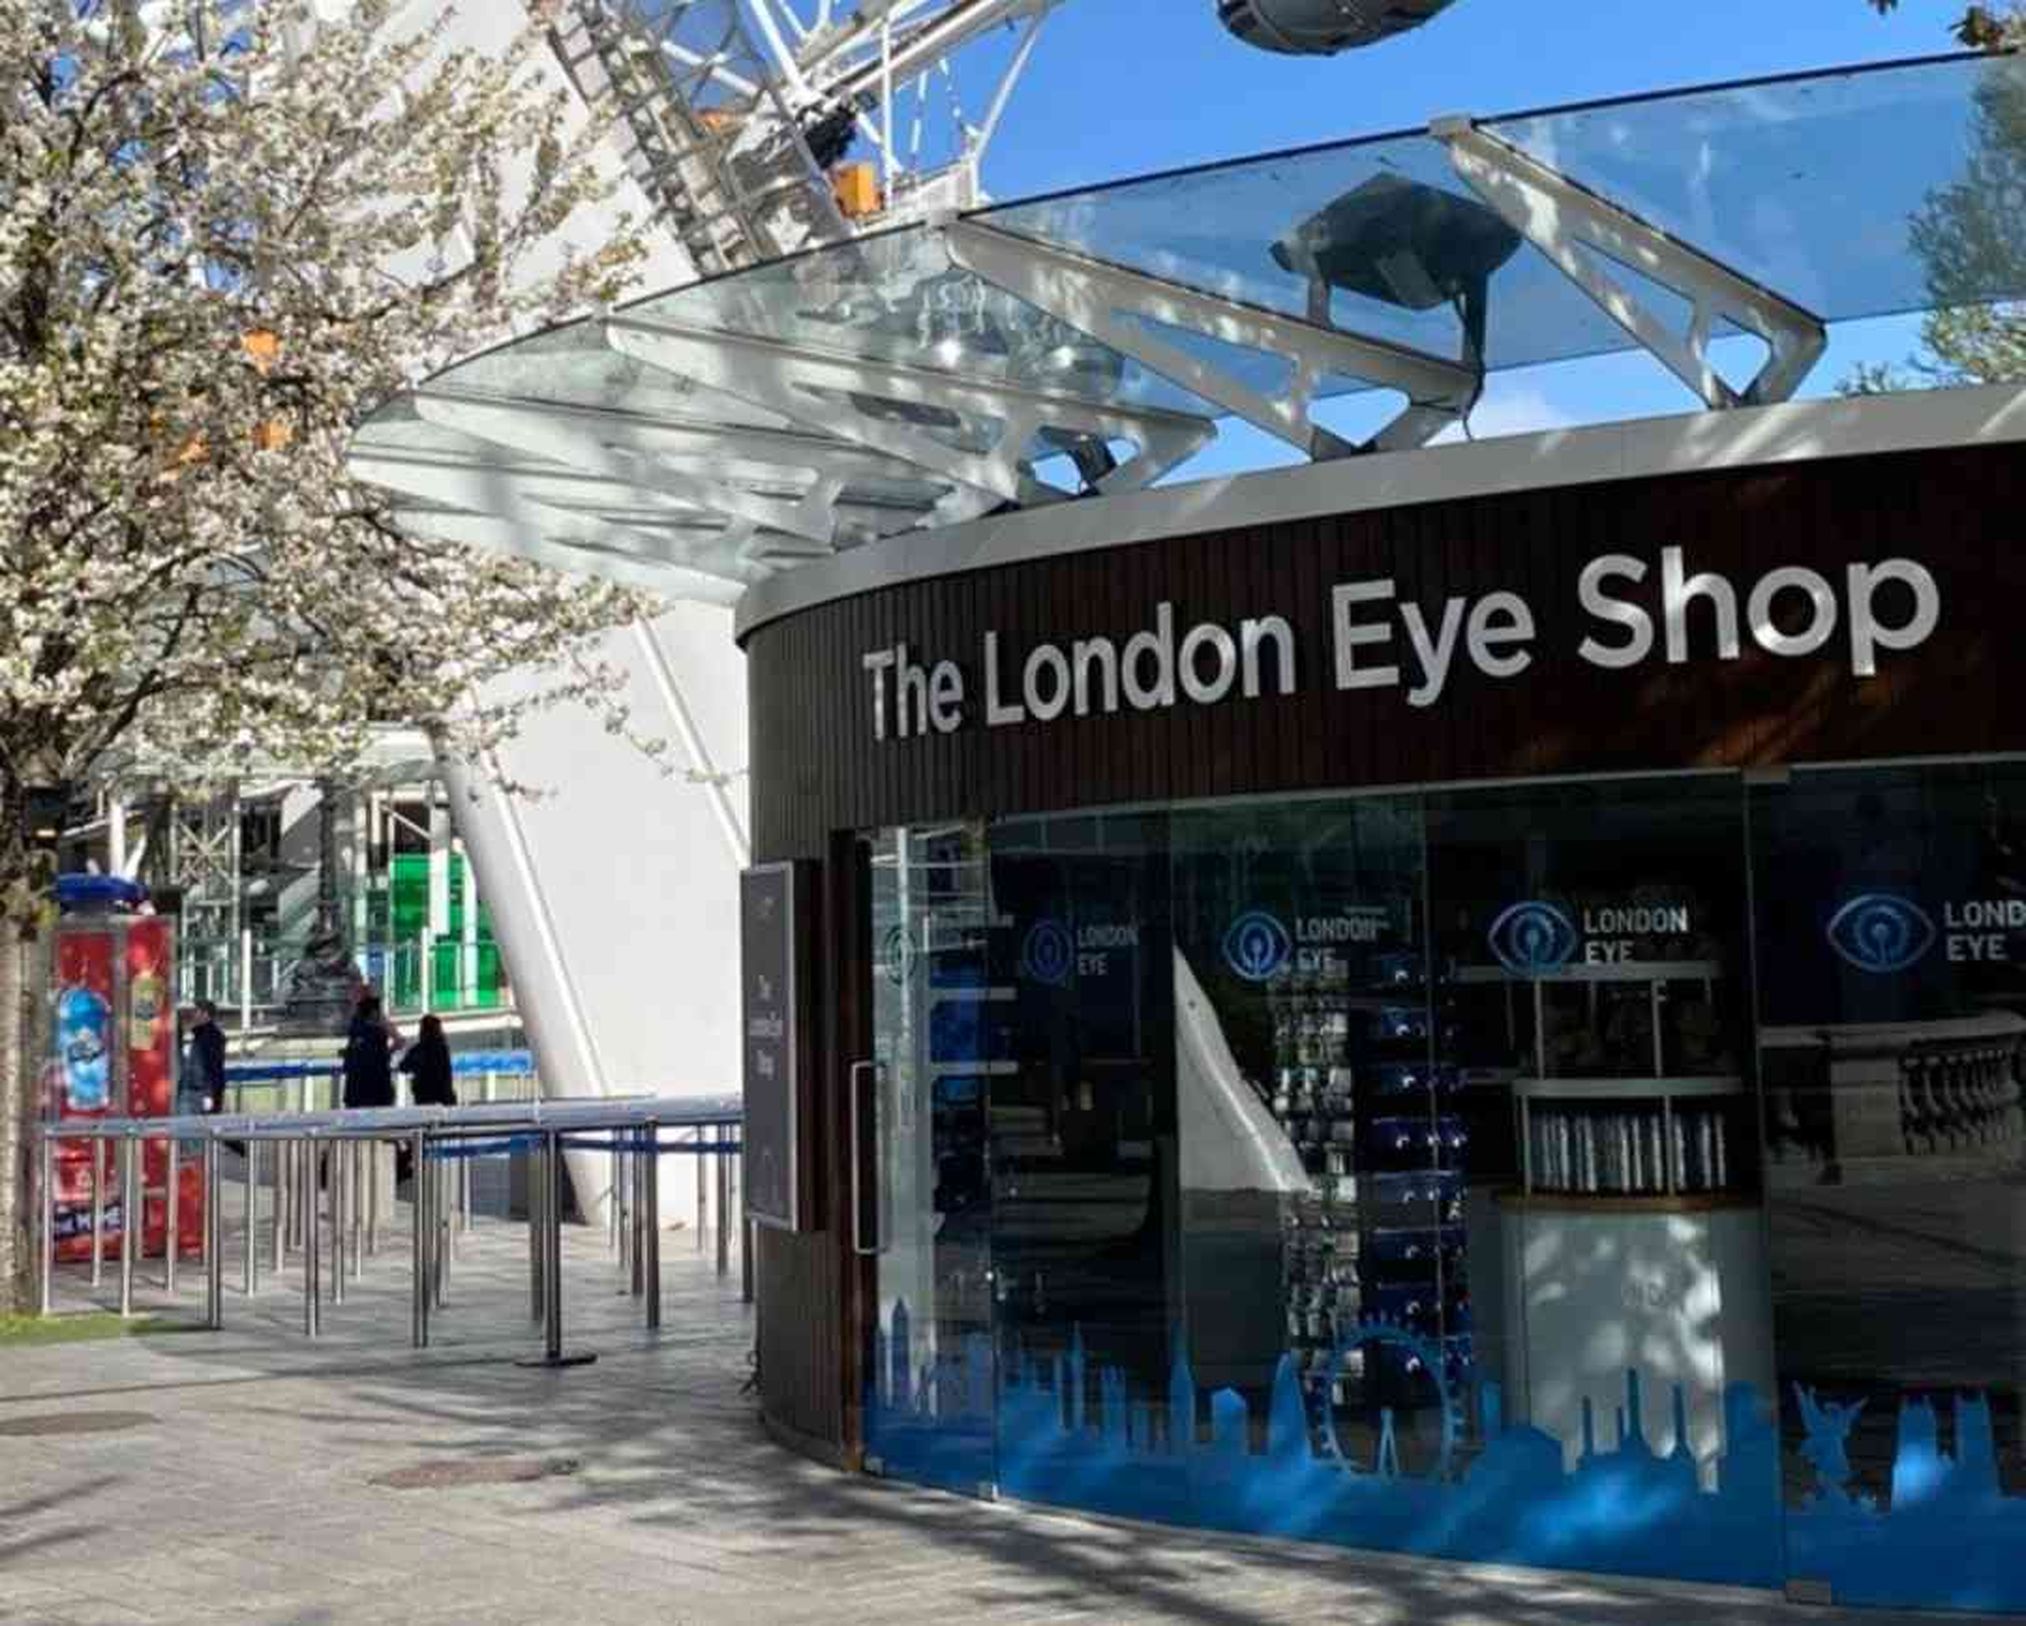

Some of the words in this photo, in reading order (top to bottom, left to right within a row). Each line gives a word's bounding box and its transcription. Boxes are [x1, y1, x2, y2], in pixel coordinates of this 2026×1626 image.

[862, 642, 964, 741] The
[984, 602, 1296, 726] London
[1332, 579, 1536, 707] Eye
[1578, 546, 1941, 676] Shop
[1296, 916, 1378, 942] LONDON
[1583, 903, 1690, 934] LONDON
[1584, 940, 1635, 965] EYE
[1945, 932, 2010, 962] EYE
